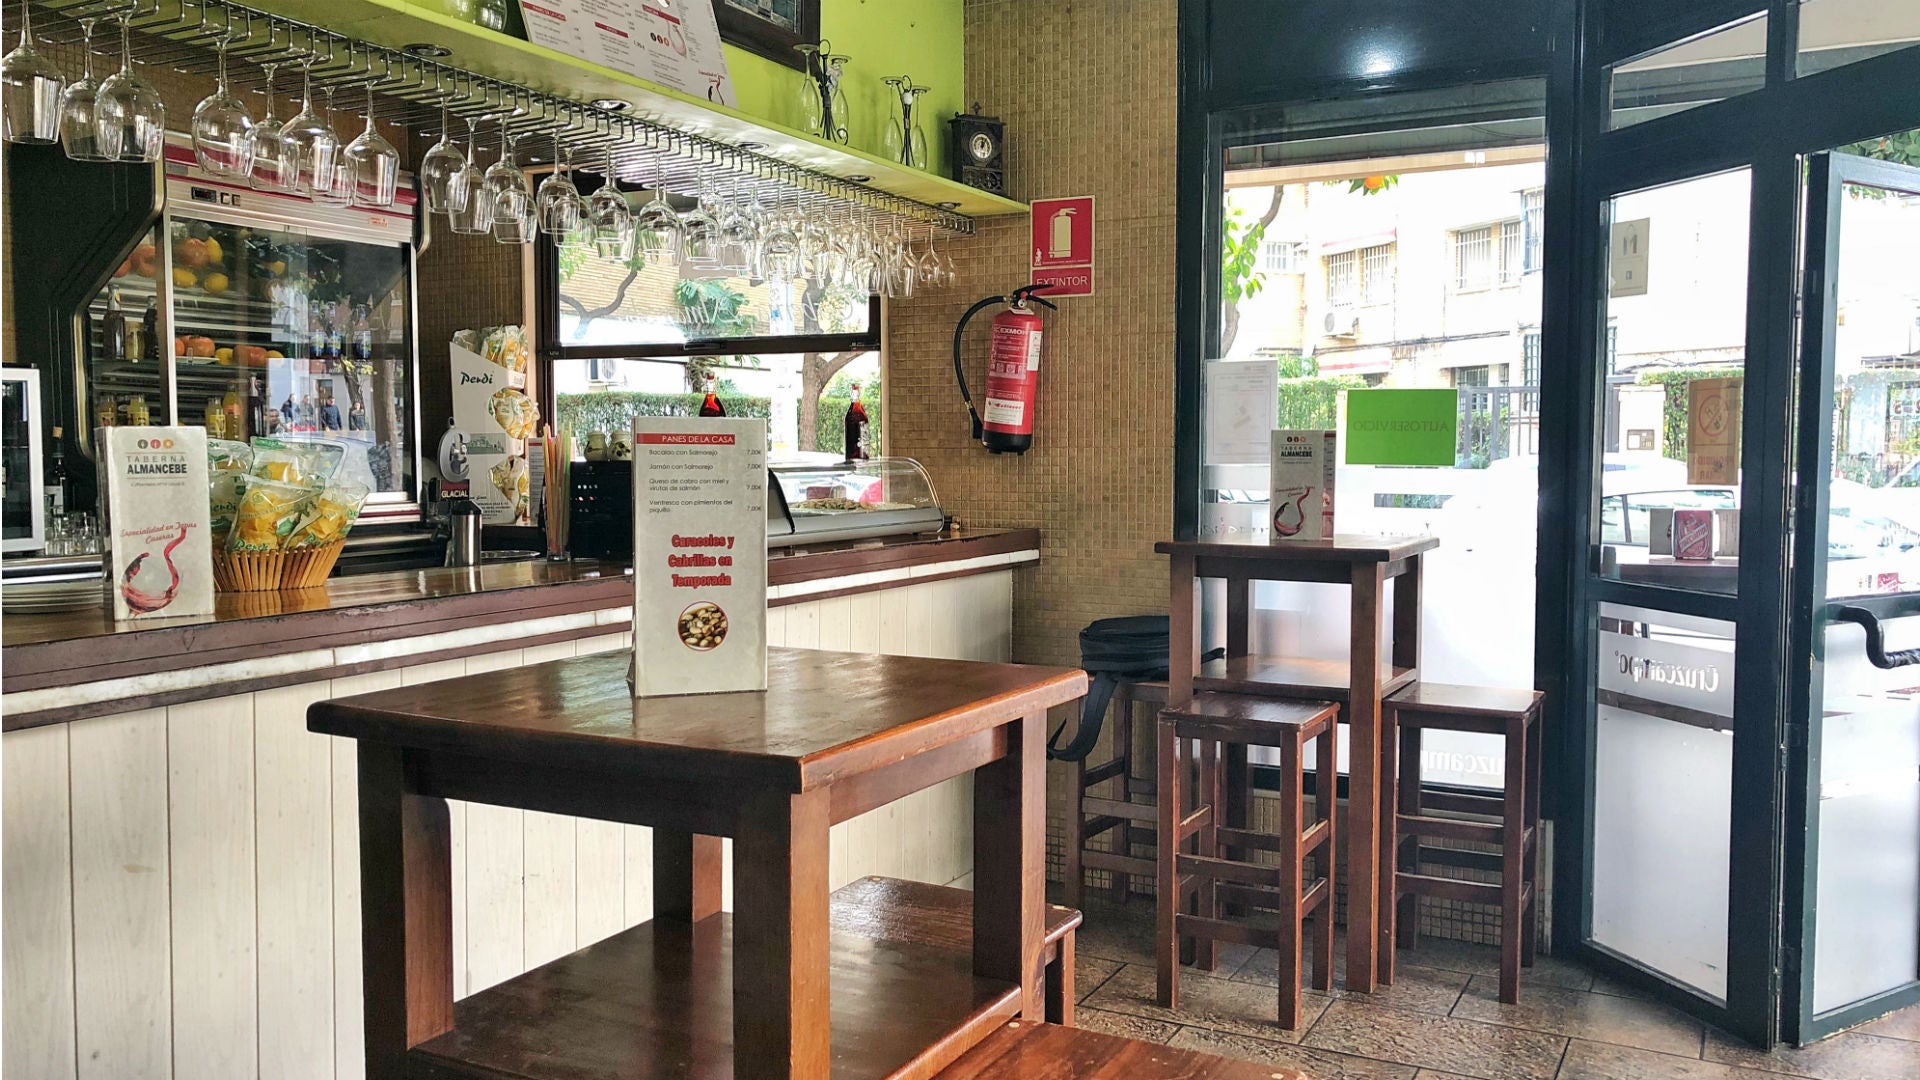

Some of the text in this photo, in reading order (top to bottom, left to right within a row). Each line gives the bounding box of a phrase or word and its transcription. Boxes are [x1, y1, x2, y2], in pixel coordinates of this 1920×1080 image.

[1036, 276, 1088, 288] EXTINTOR
[662, 435, 687, 443] PANES
[711, 436, 734, 444] CASA
[127, 463, 188, 475] ALMANCEBE
[441, 490, 469, 498] GLACIAL
[120, 525, 165, 537] Especialidad
[145, 533, 175, 544] Caseras
[671, 534, 735, 549] Caracoles y
[668, 554, 733, 567] Cabrillas en
[671, 573, 732, 589] Temporada
